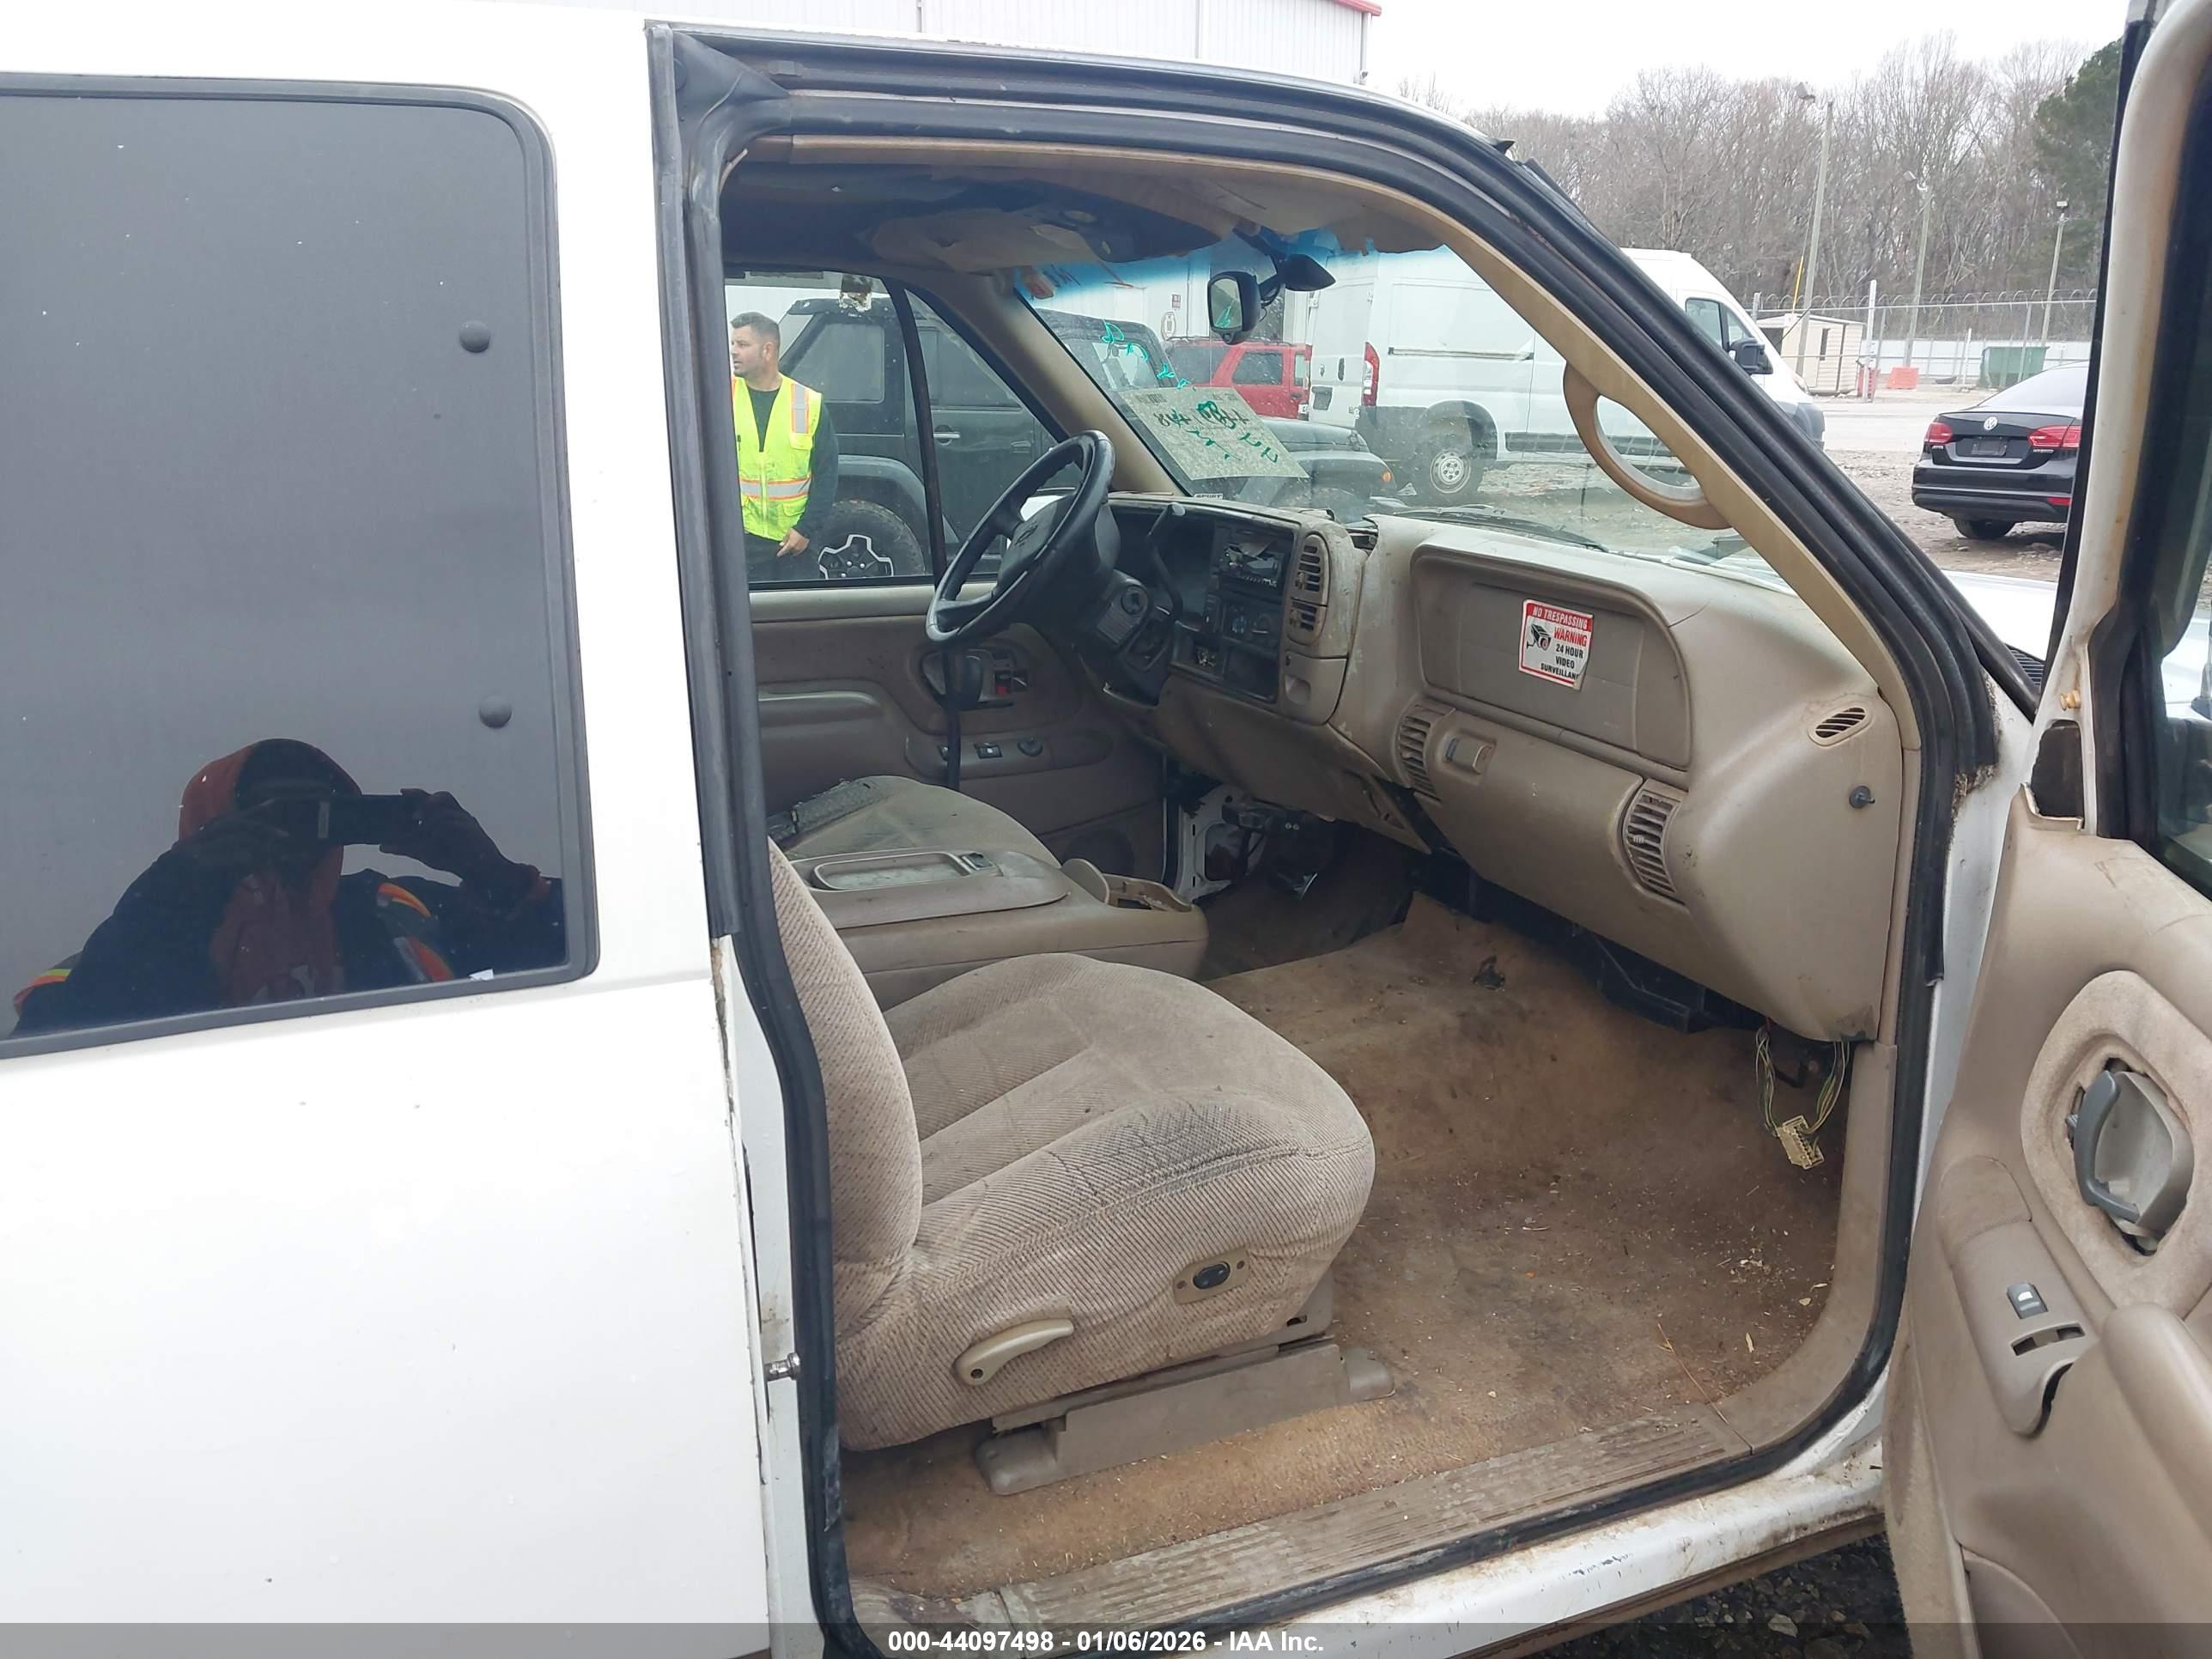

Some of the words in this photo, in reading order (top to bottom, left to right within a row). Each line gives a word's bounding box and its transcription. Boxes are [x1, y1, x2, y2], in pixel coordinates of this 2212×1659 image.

[1533, 606, 1542, 617] NO
[1544, 609, 1588, 629] TRESPASSING
[1553, 626, 1588, 647] WARNING
[1556, 643, 1564, 653] 24
[1565, 646, 1583, 659] HOUR
[1555, 655, 1575, 669] VIDEO
